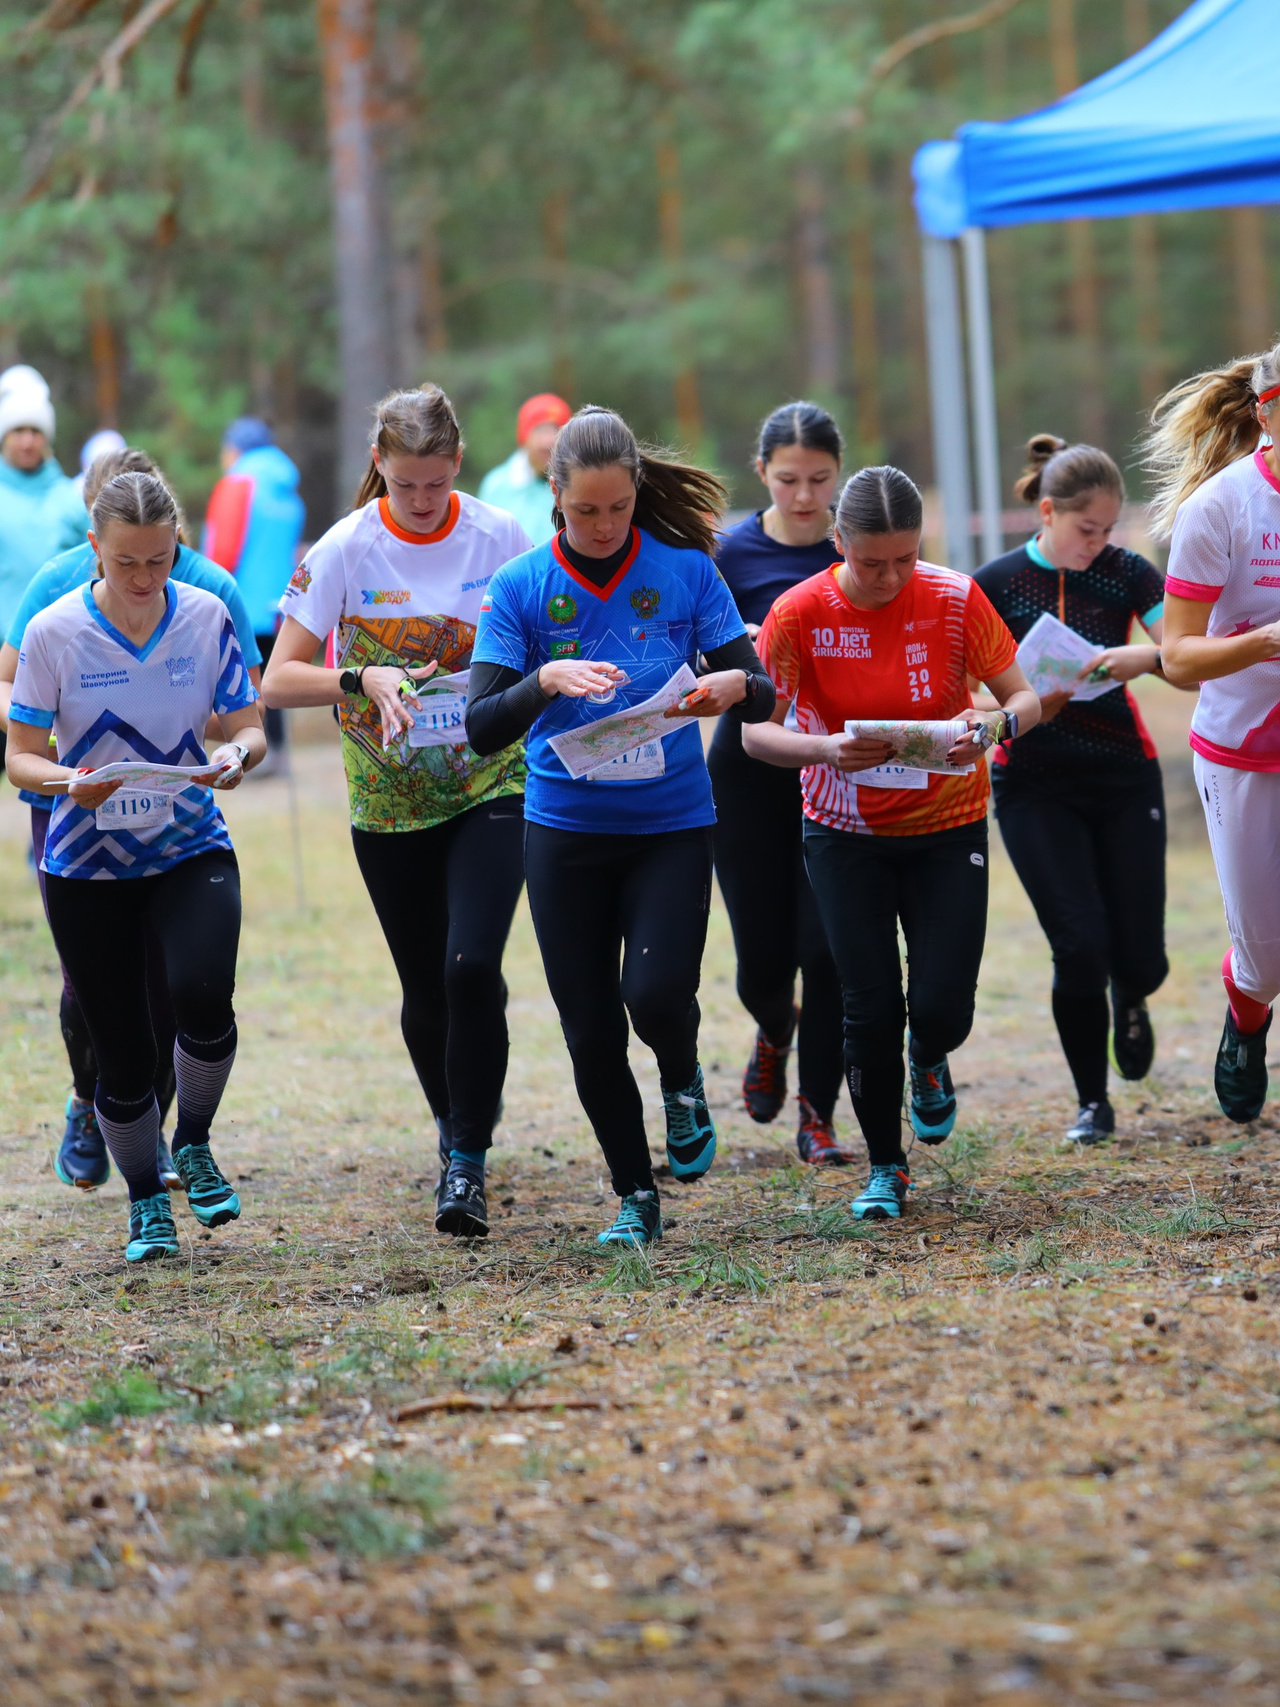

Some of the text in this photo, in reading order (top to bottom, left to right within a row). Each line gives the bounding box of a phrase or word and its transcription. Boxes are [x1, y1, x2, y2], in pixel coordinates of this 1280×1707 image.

[811, 628, 835, 647] 10
[556, 643, 574, 653] SFR
[812, 647, 872, 659] SIRIUS SOCHI
[905, 643, 921, 654] IRON
[906, 651, 928, 667] LADY
[80, 669, 128, 680] Екатерина
[908, 668, 930, 686] 20
[80, 677, 130, 689] Шавкунова
[911, 684, 932, 702] 24
[431, 711, 461, 730] 118
[121, 797, 152, 816] 119
